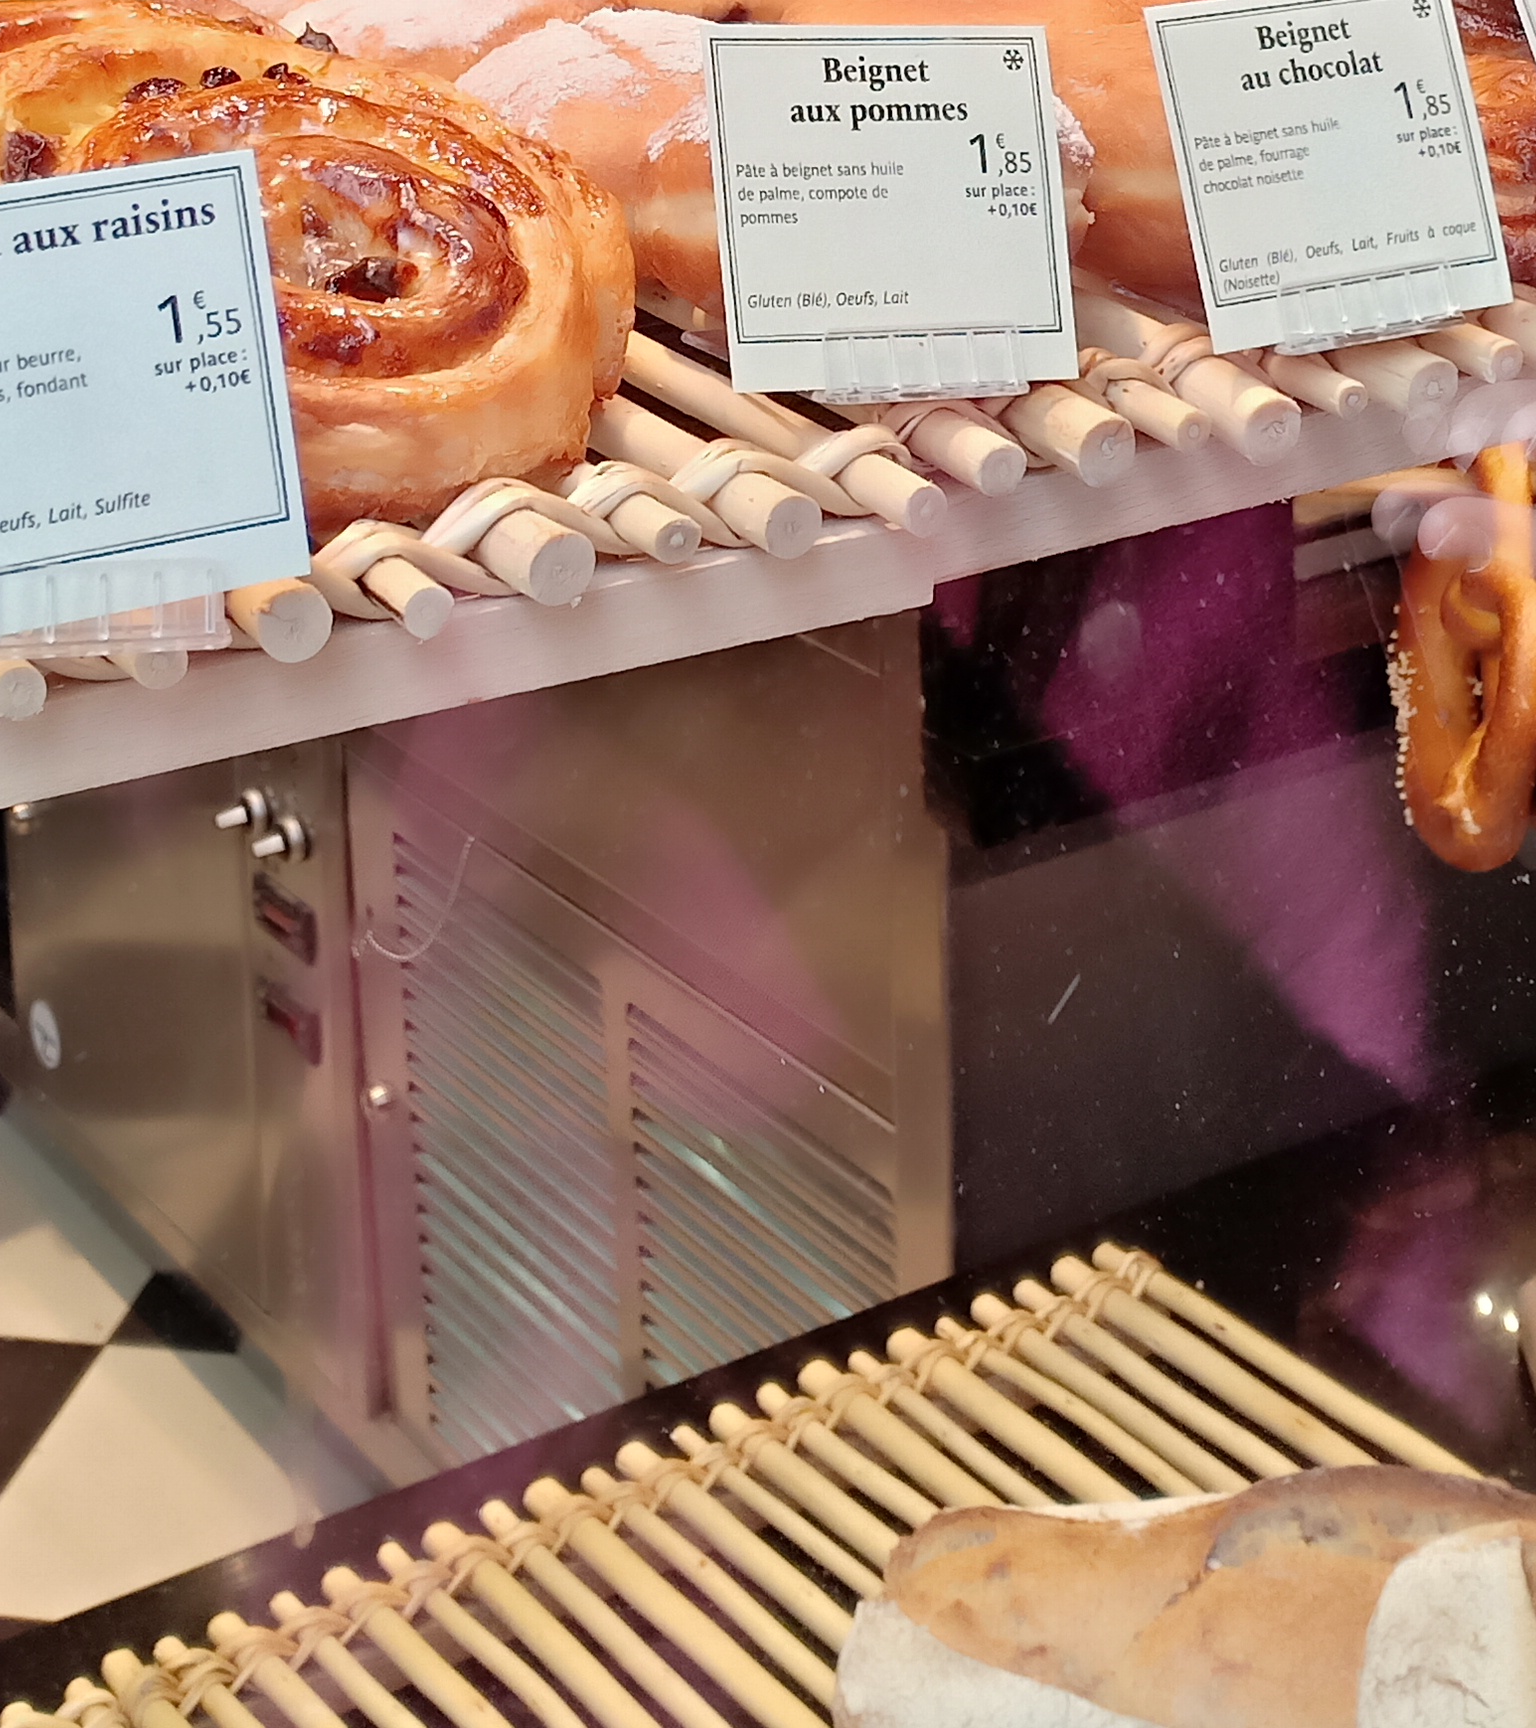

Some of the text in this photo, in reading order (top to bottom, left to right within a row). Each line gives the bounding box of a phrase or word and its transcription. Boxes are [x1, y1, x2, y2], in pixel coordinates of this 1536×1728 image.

[1255, 18, 1352, 52] Beignet
[821, 56, 930, 92] Beignet
[1240, 51, 1384, 91] au chocolat
[790, 102, 968, 131] aux pommes
[735, 161, 904, 181] Pâte à beignet sans huile
[737, 185, 888, 204] de palme, compote de
[964, 186, 987, 198] sur
[12, 224, 81, 255] aux
[91, 201, 216, 242] raisins
[739, 212, 799, 228] pommes
[747, 290, 909, 309] Gluten (Blé), Oeufs, Lait
[16, 348, 81, 371] beurre,
[154, 359, 183, 377] sur
[16, 373, 88, 399] fondant
[48, 503, 88, 525] Lait,
[94, 491, 151, 516] Sulfite
